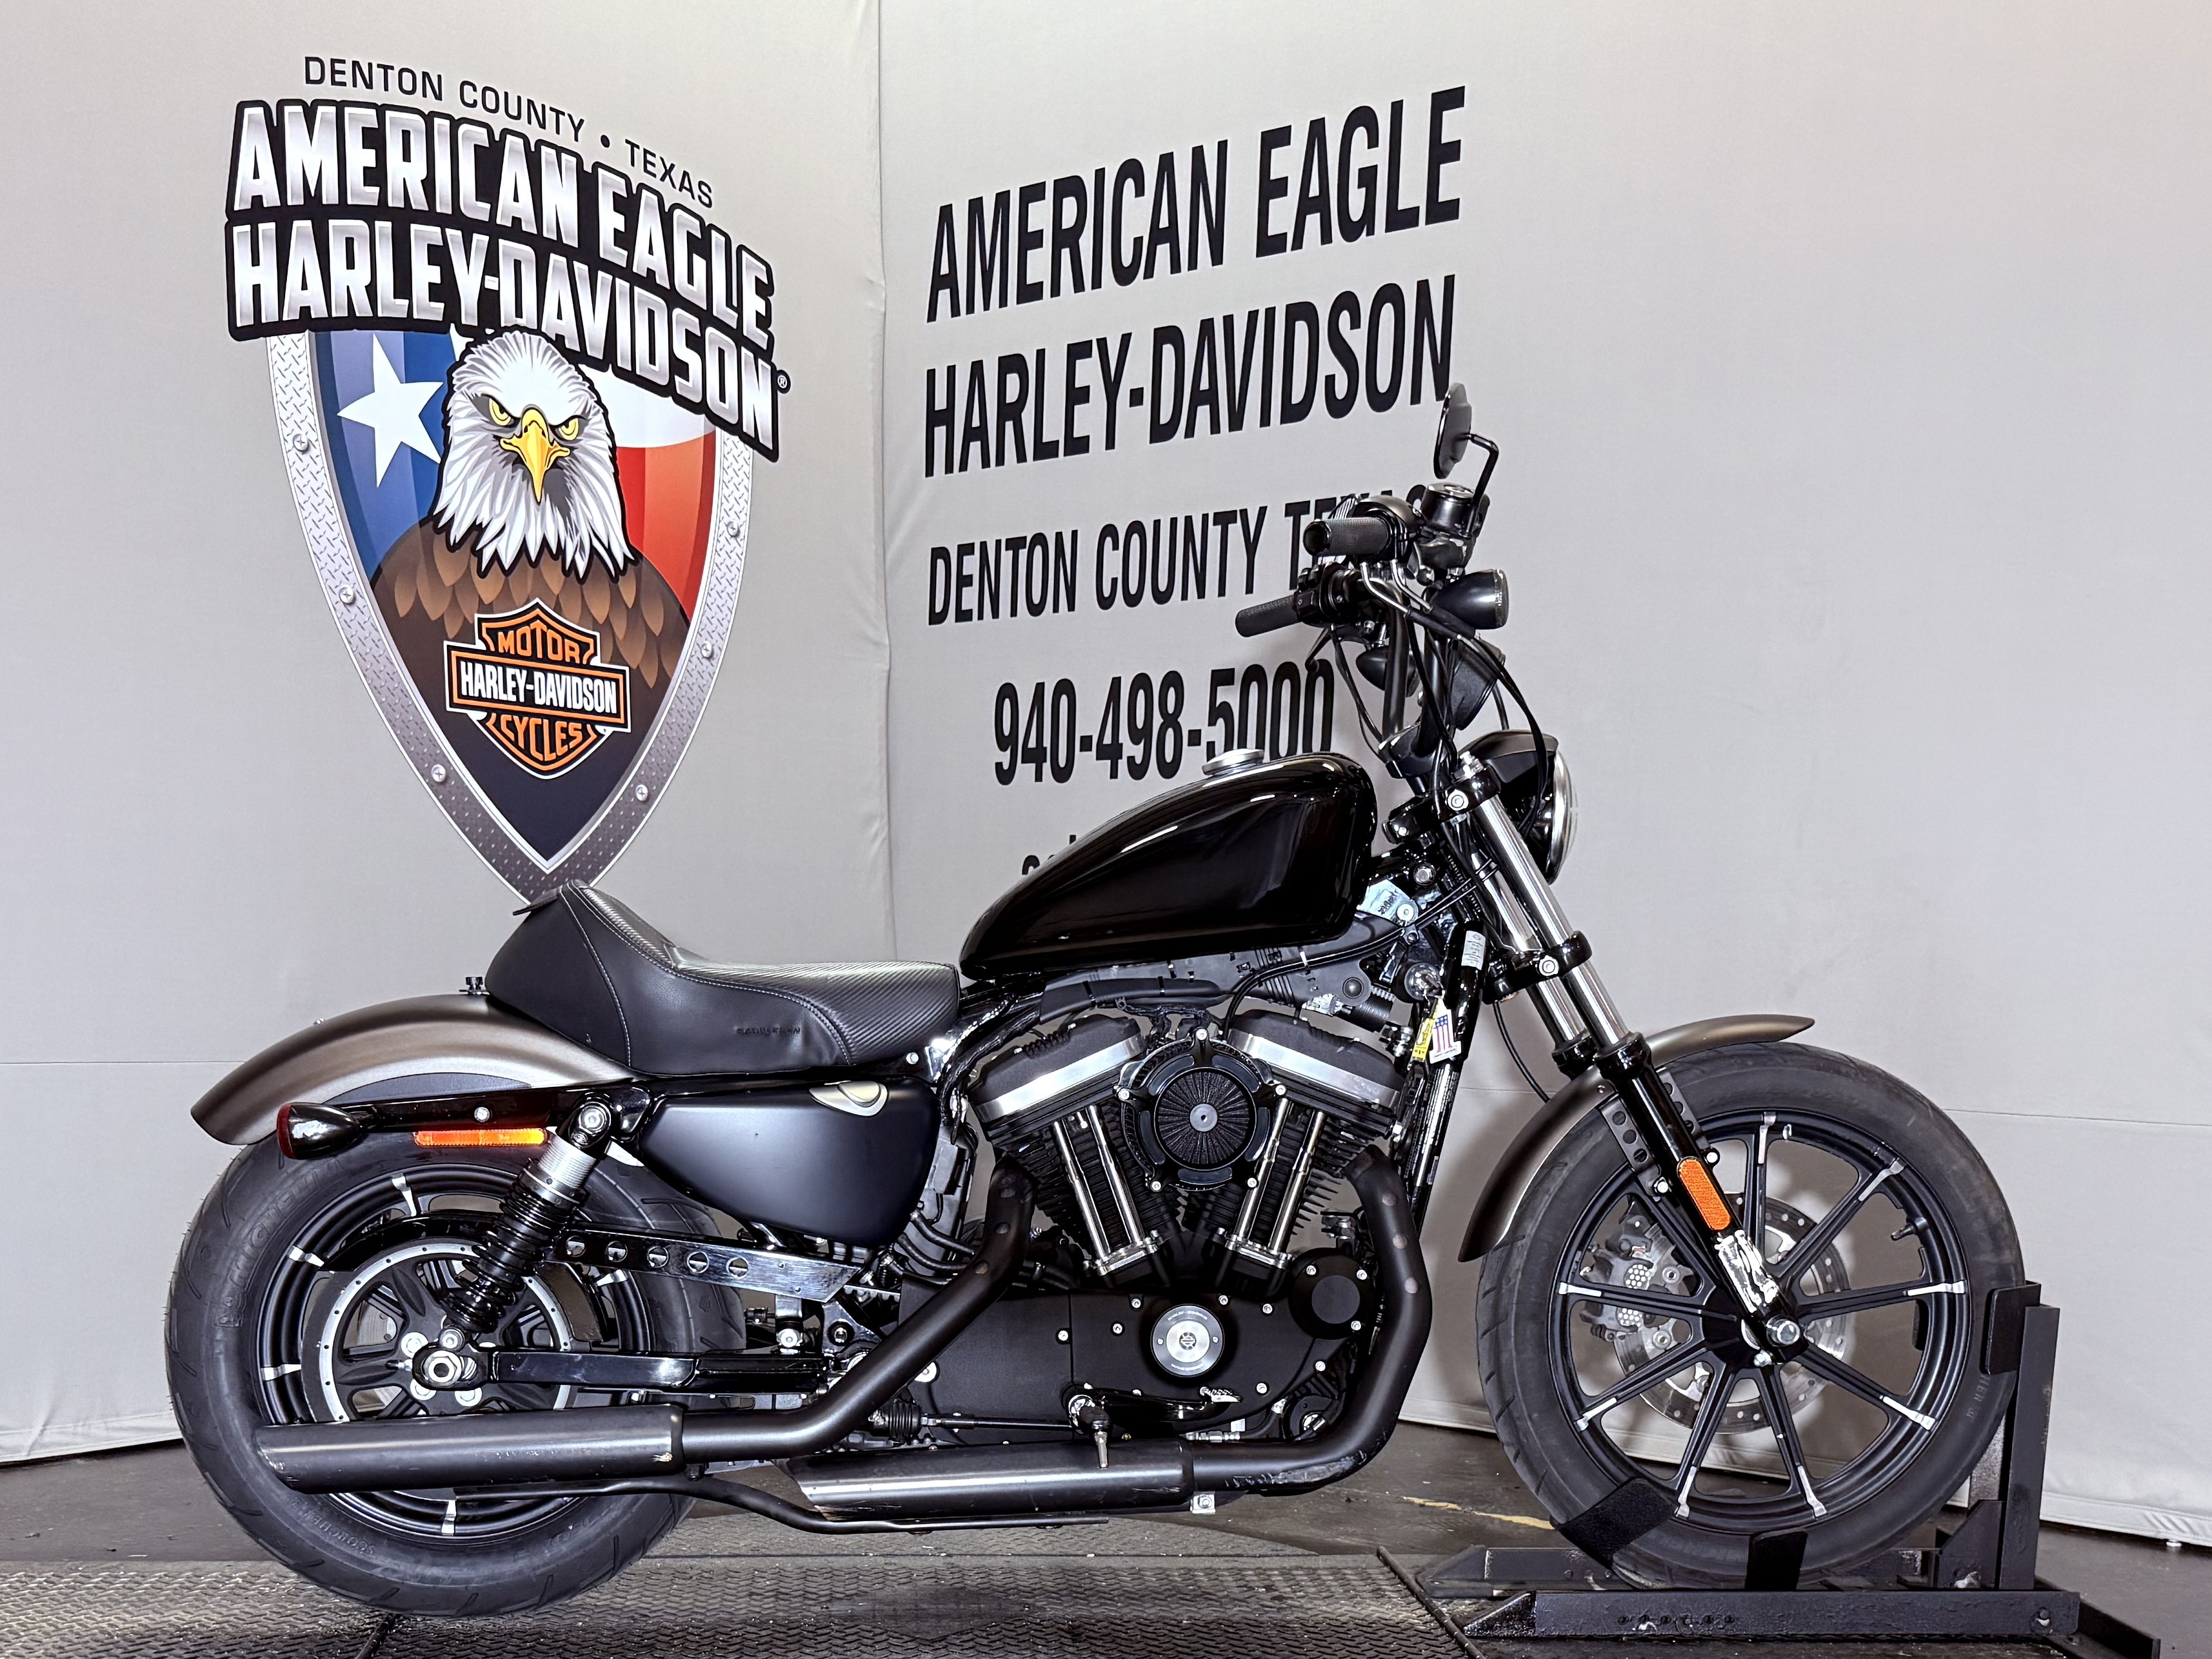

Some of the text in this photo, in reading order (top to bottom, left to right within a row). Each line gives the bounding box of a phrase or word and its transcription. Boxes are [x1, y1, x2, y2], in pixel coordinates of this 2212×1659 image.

[305, 56, 713, 208] DENTON COUNTY TEXAS
[234, 105, 770, 351] AMERICAN EAGLE
[927, 85, 1466, 323] AMERICAN EAGLE
[232, 219, 774, 451] HARLEY-DAVIDSON
[925, 274, 1456, 478] HARLEY-DAVIDSON
[928, 529, 1079, 626] DENTON
[1095, 505, 1268, 611] COUNTY
[460, 661, 617, 714] HARLEY-DAVIDSON
[498, 619, 580, 664] MOTOR
[501, 715, 583, 762] CYCLES
[994, 658, 1335, 786] 940-498-5000
